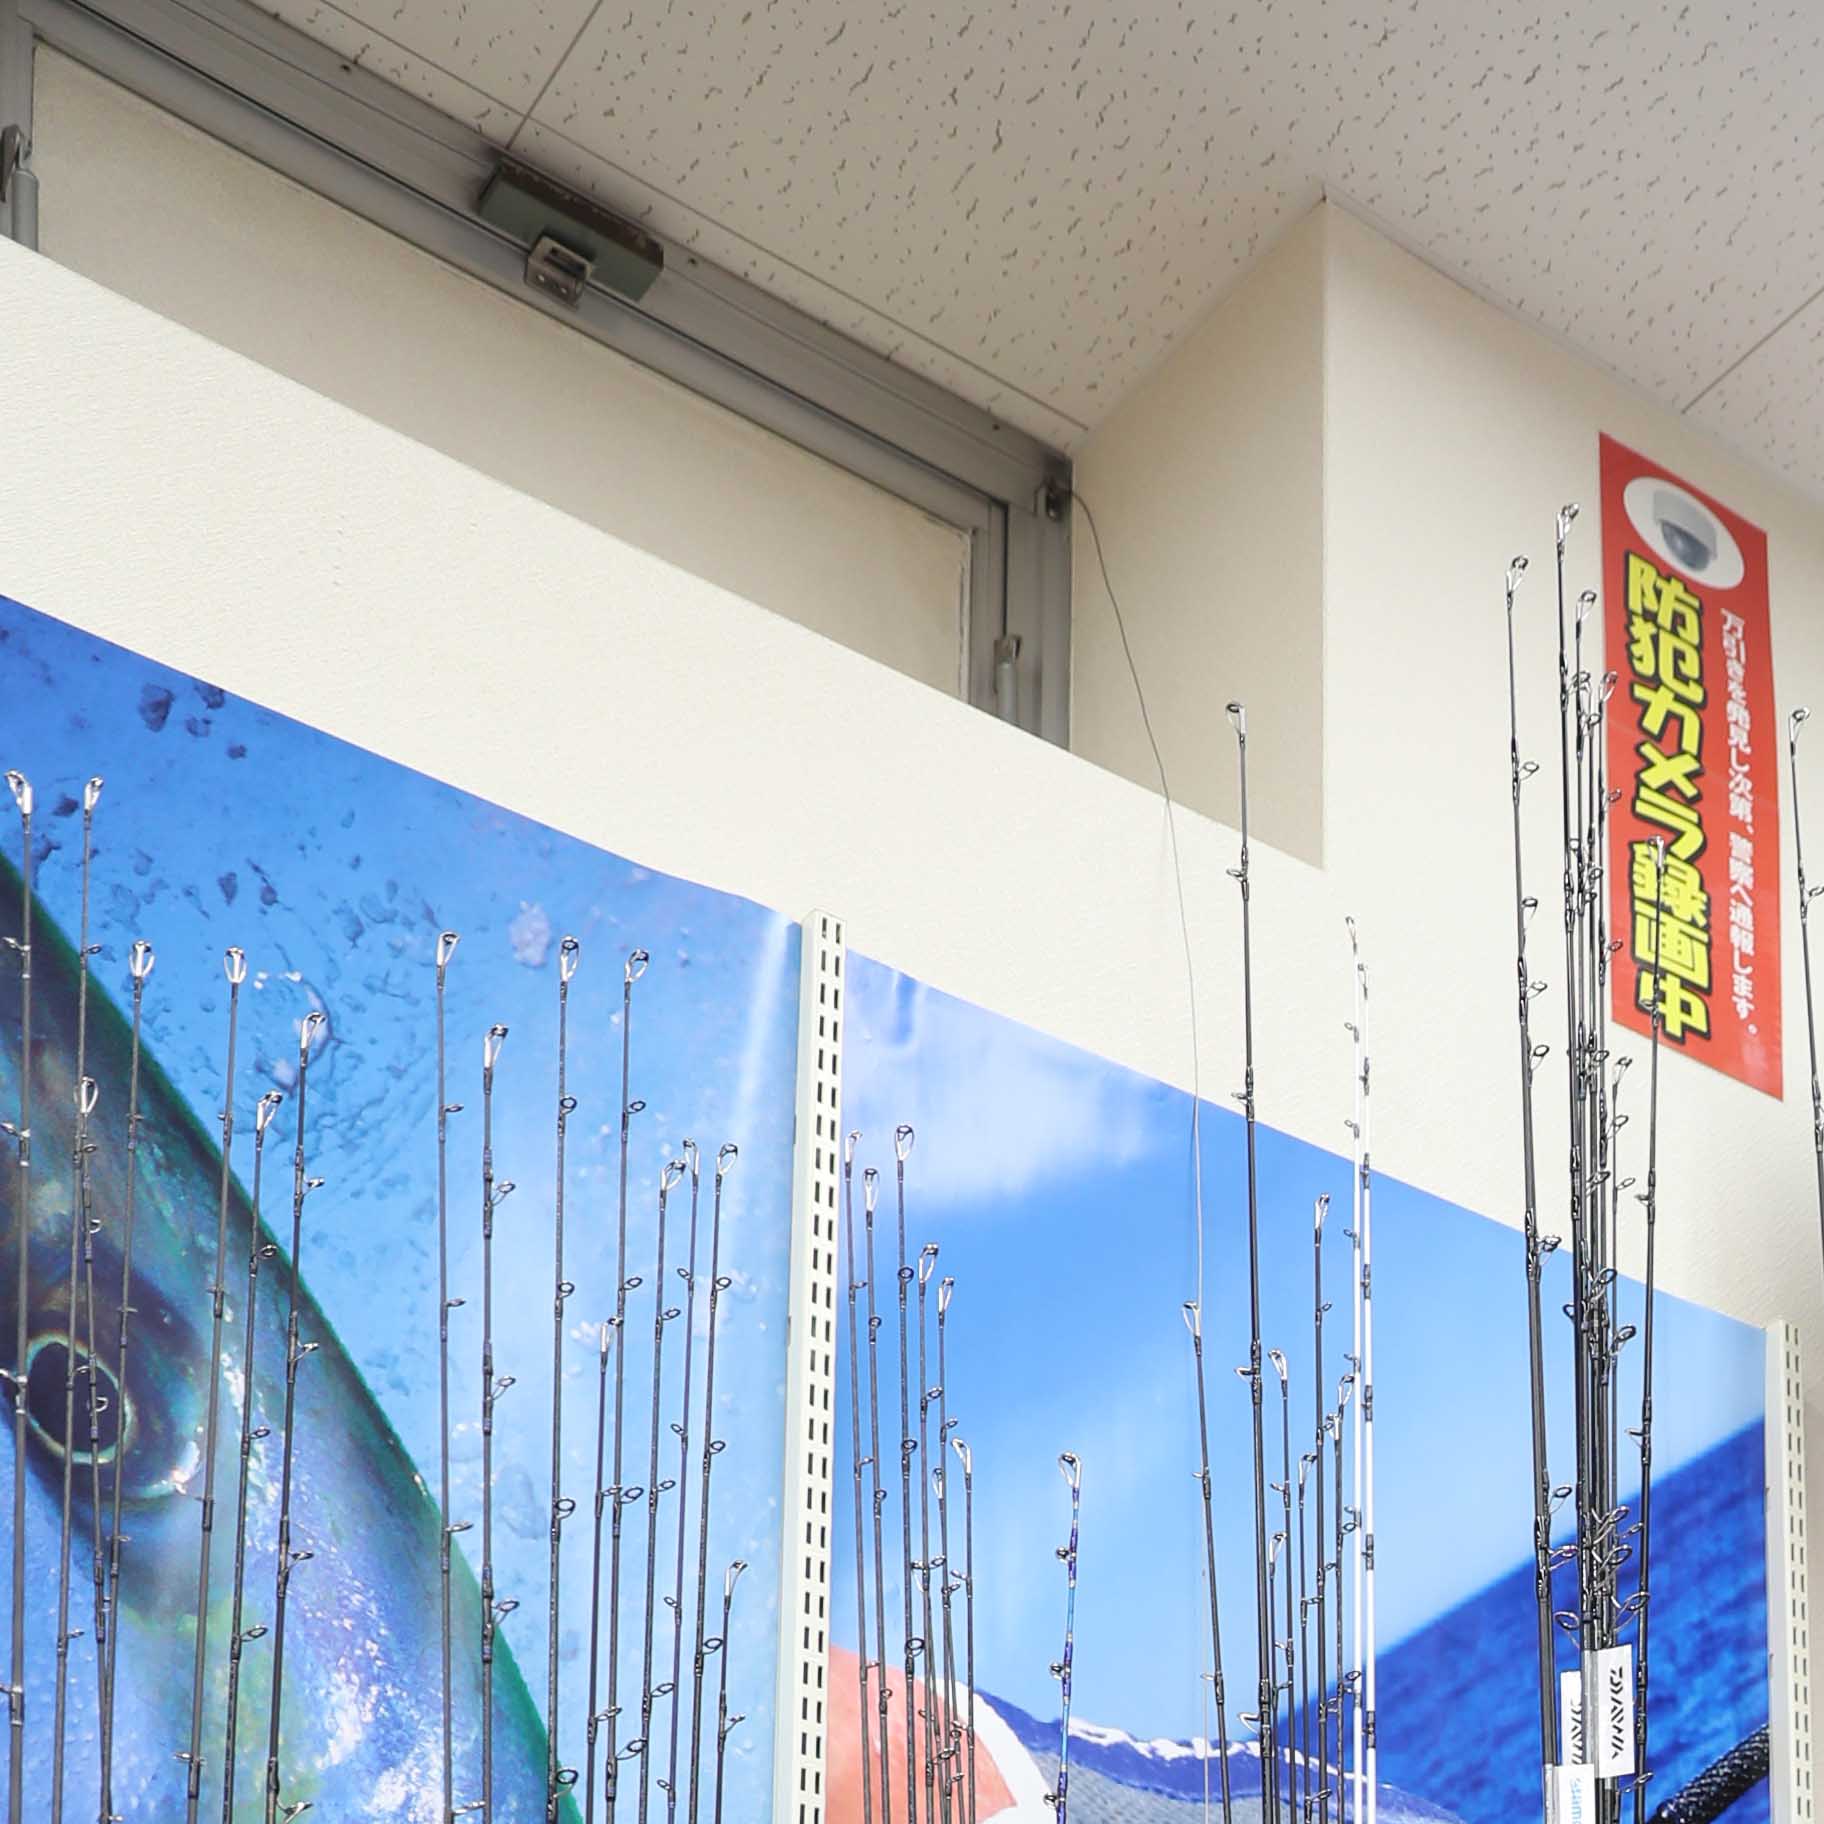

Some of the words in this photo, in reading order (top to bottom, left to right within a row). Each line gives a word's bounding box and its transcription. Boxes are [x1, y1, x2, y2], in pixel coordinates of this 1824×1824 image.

[1625, 548, 1710, 1042] 防犯カメラ録画中
[1609, 1665, 1626, 1759] DAIWA
